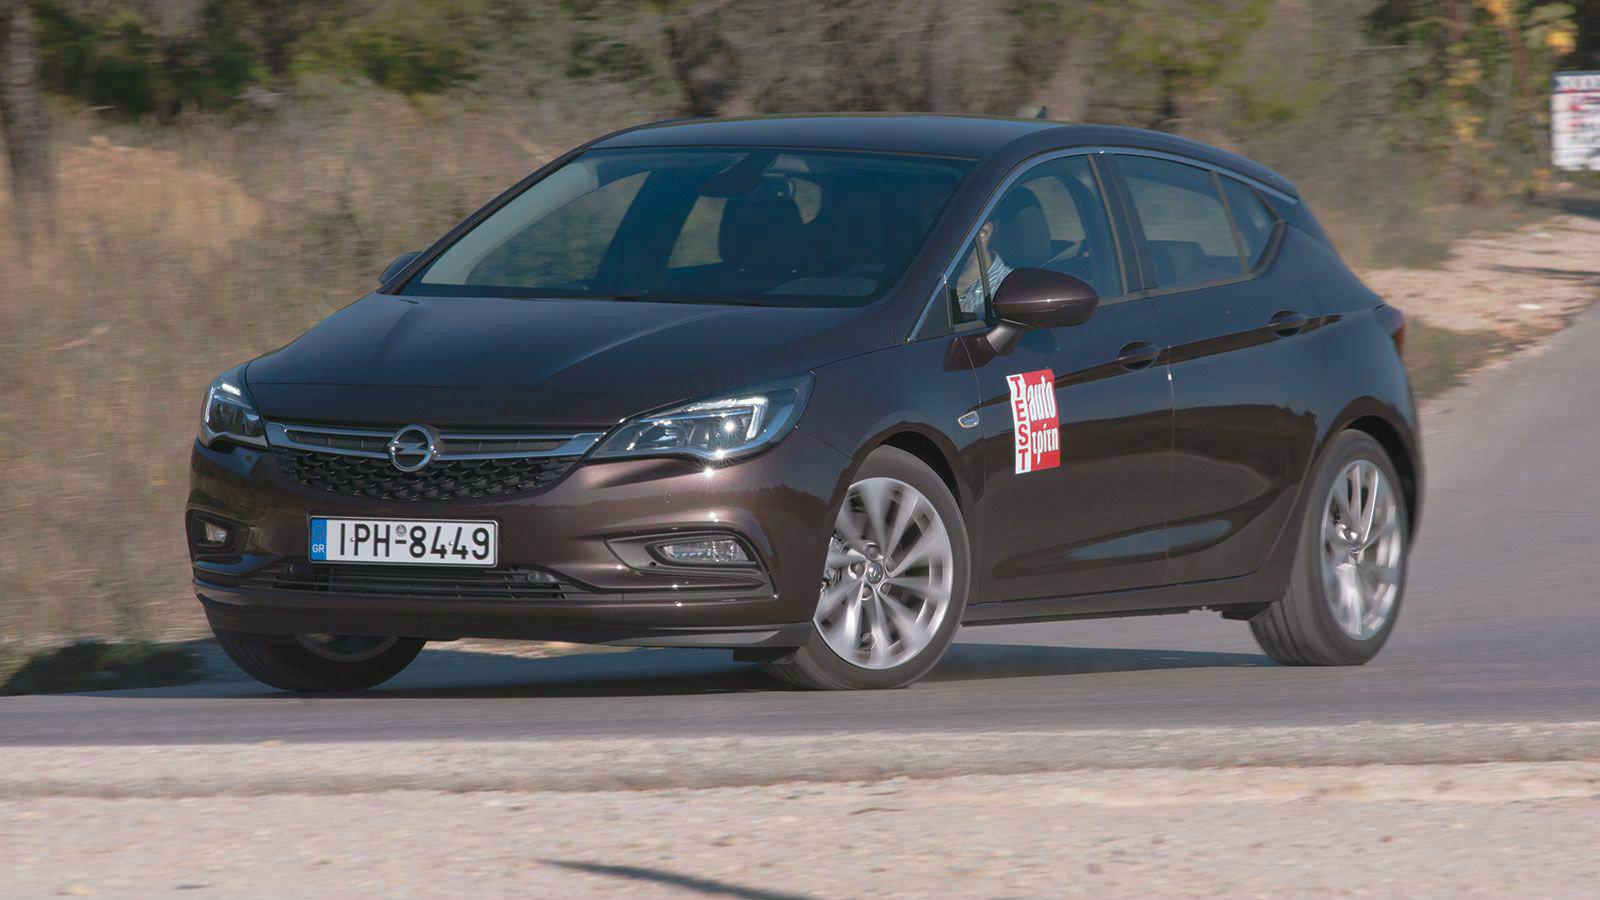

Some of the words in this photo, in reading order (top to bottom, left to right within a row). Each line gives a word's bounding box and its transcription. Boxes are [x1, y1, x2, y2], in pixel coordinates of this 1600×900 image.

[1027, 374, 1056, 422] auto
[1010, 376, 1029, 471] TEST
[312, 543, 325, 553] GR
